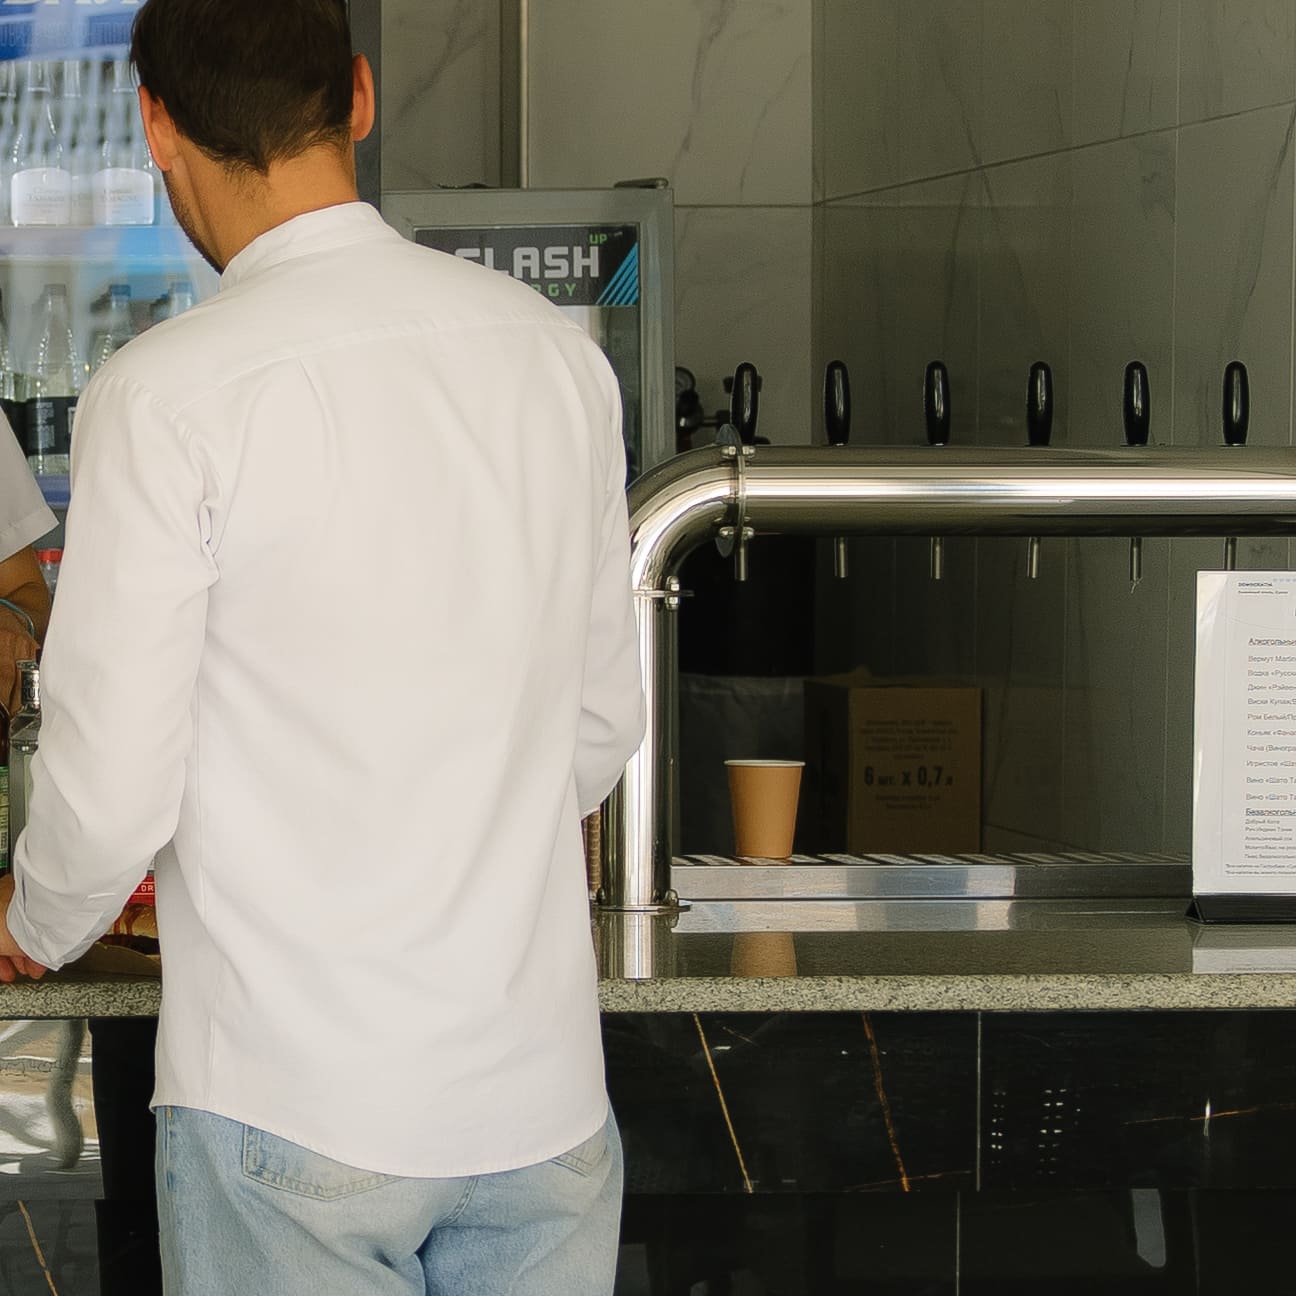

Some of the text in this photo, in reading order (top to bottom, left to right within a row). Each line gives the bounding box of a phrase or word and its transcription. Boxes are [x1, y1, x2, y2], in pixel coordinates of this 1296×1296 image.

[588, 233, 608, 245] UP
[864, 765, 874, 786] 6
[917, 765, 943, 787] 0,7
